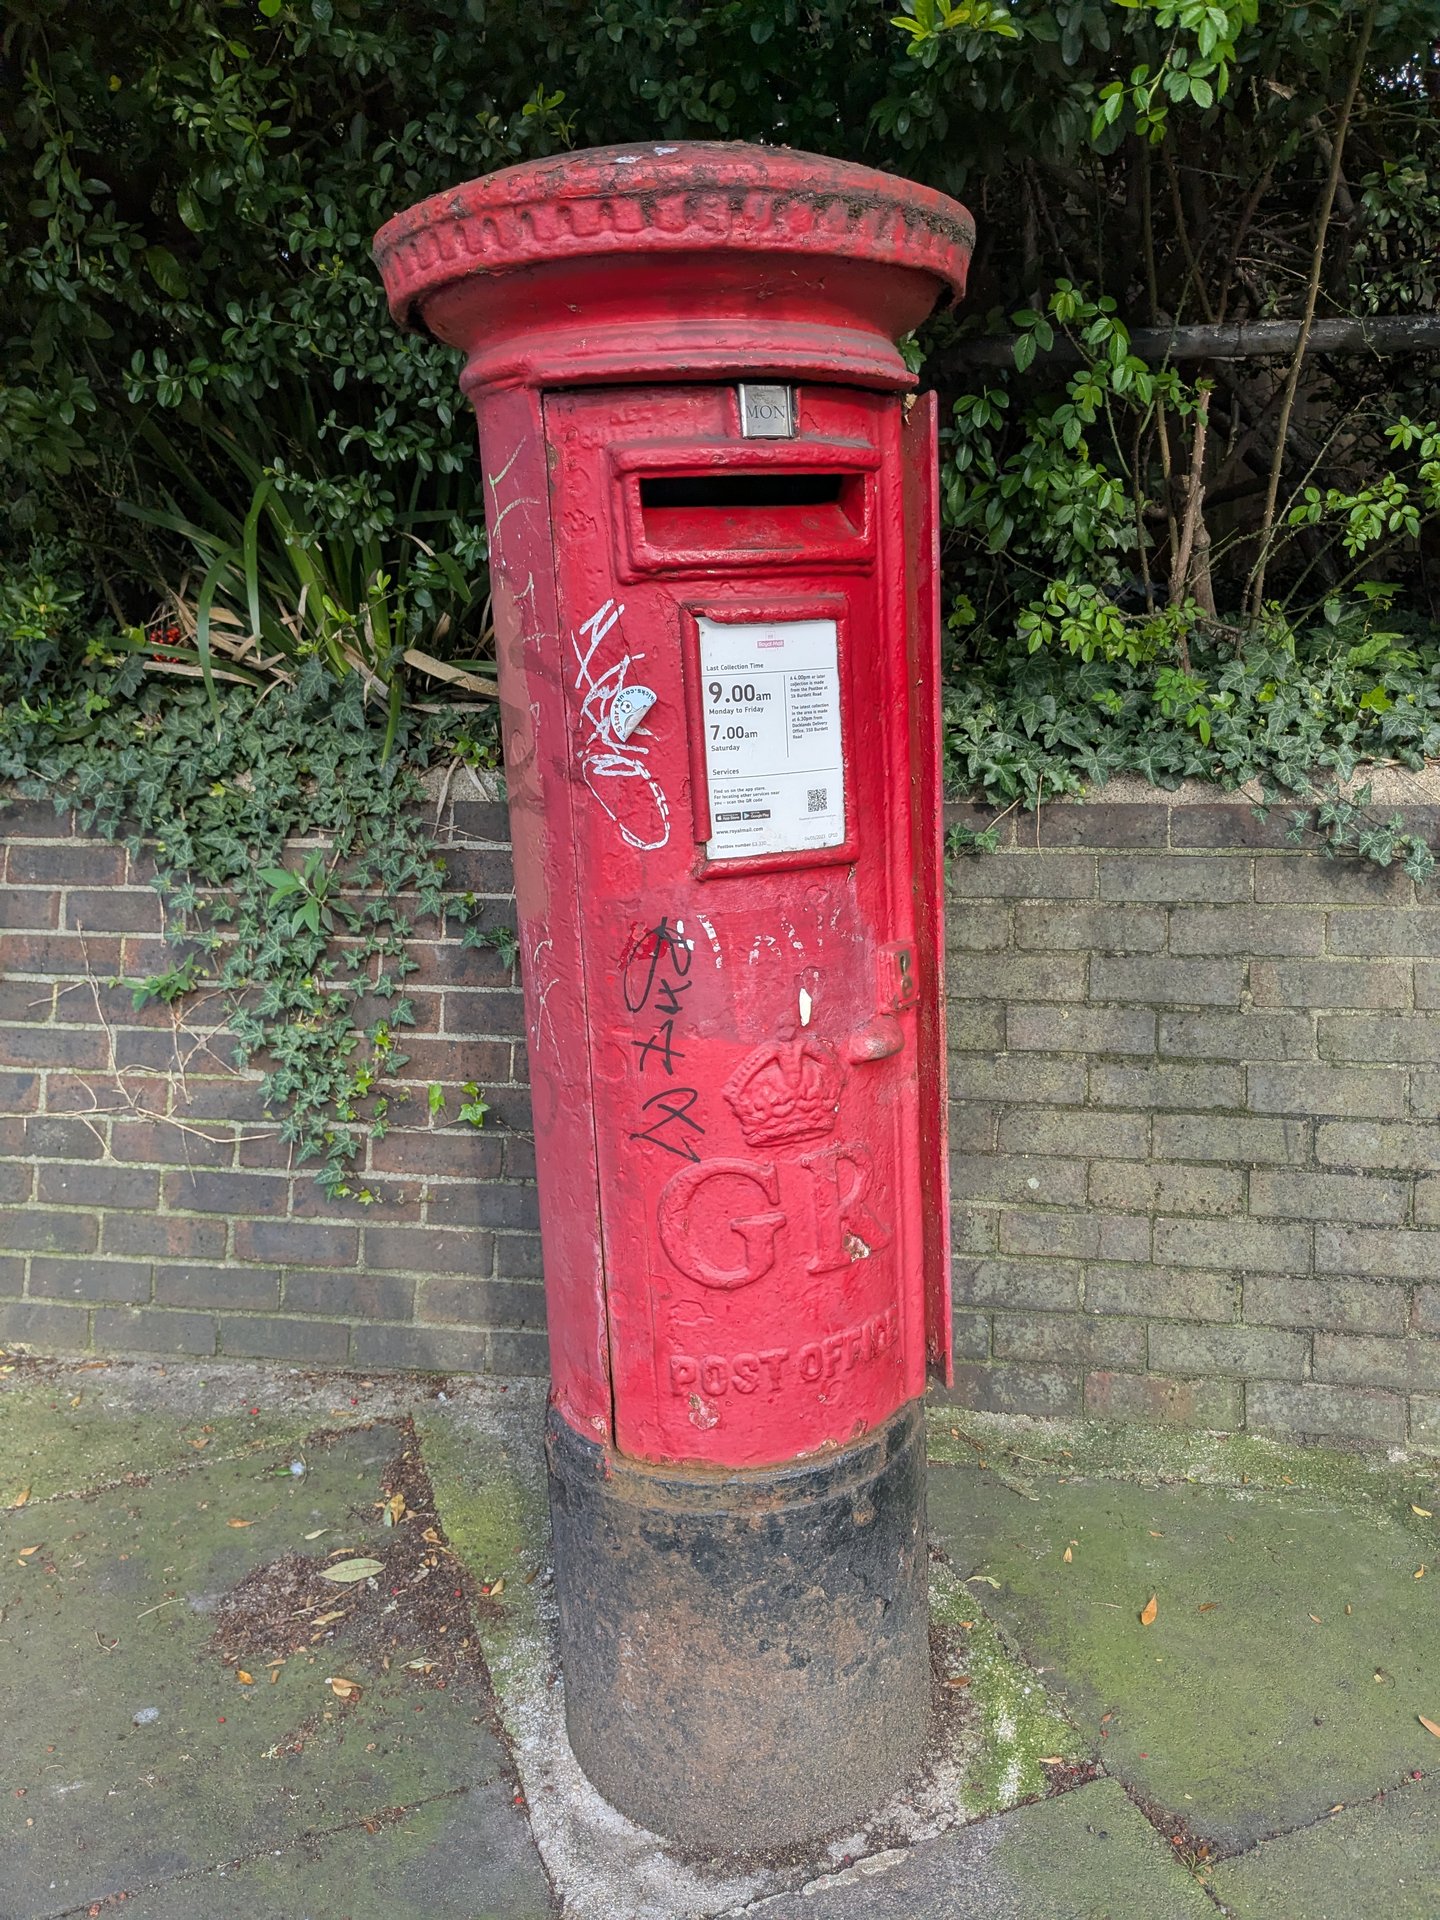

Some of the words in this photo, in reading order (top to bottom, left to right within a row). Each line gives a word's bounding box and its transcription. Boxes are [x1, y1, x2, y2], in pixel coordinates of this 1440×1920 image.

[746, 405, 786, 419] MON
[708, 682, 771, 704] 9.00am
[710, 725, 758, 740] 7.00am
[669, 1348, 789, 1397] POST
